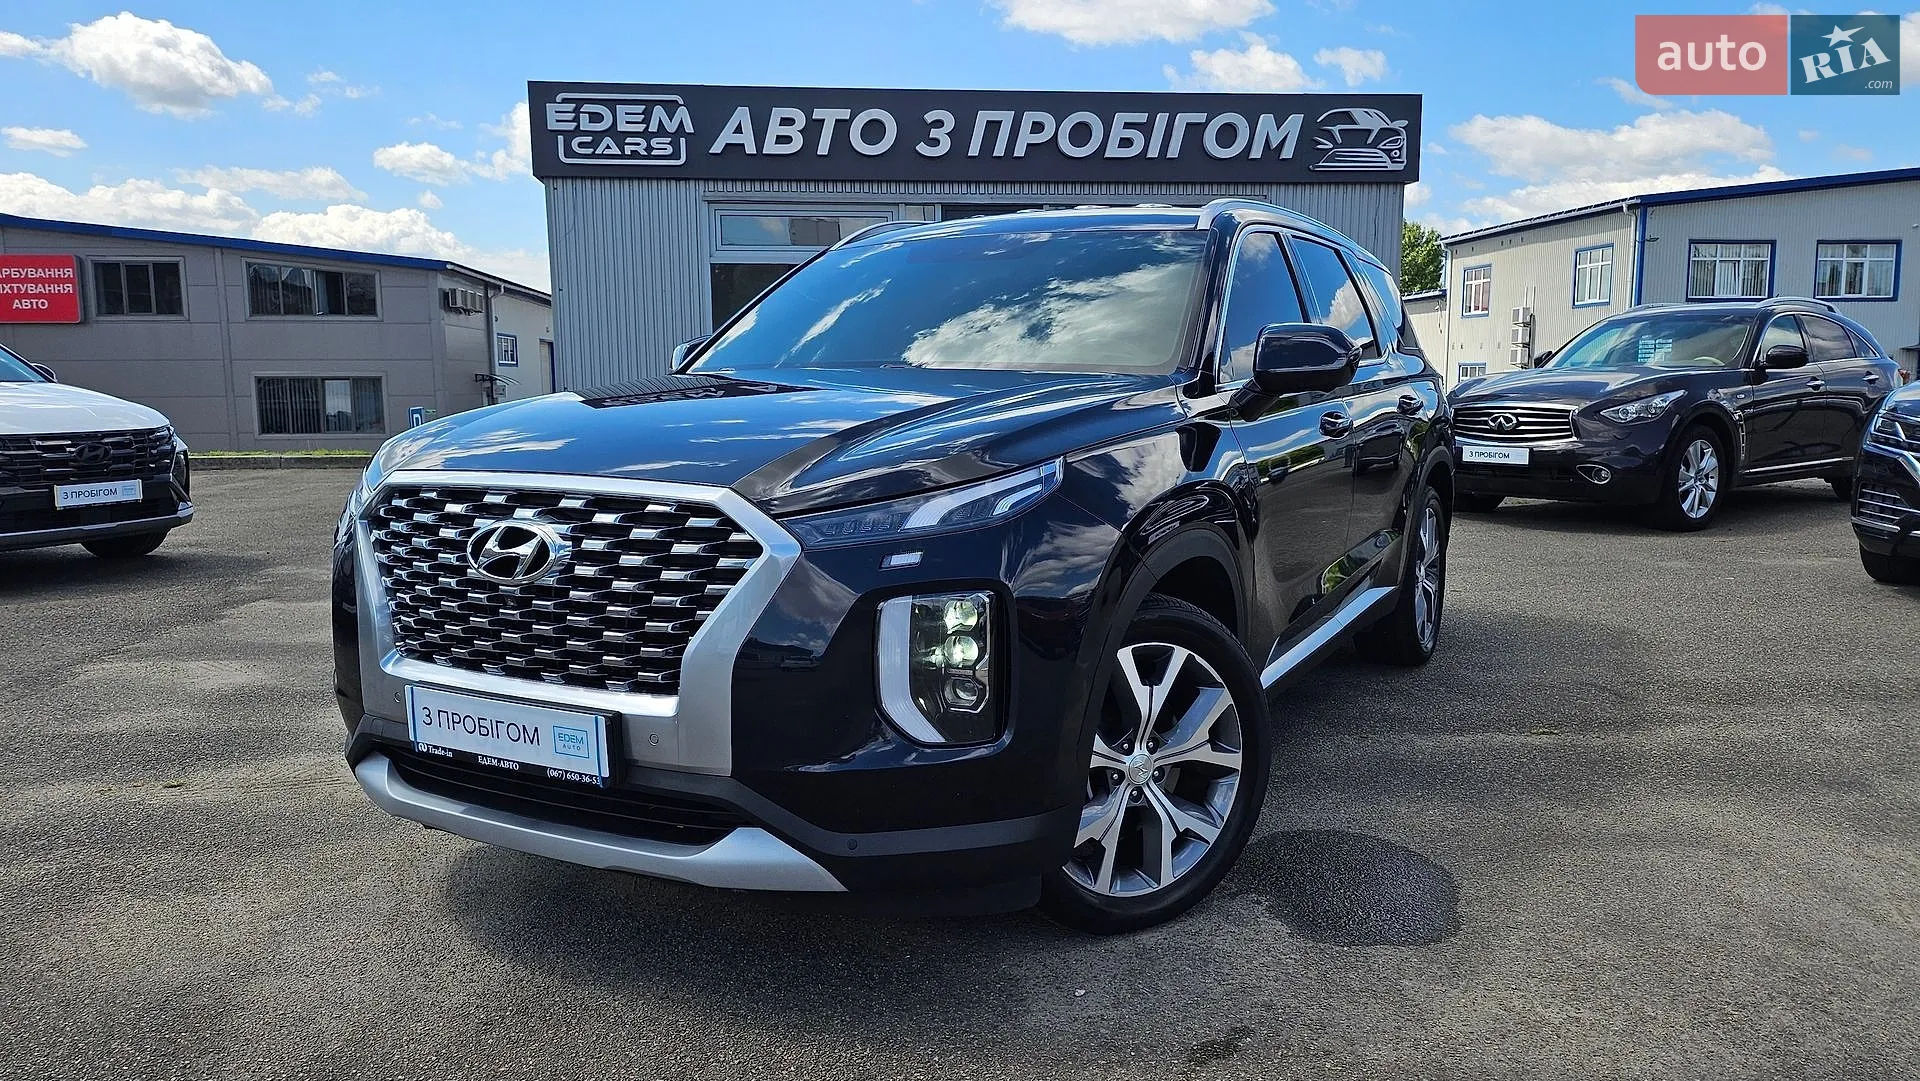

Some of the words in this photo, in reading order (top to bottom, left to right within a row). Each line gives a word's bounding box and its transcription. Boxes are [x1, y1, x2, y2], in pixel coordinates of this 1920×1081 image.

[546, 102, 695, 134] EDEM
[708, 106, 898, 156] АВТО
[914, 109, 956, 158] З
[967, 110, 1304, 159] ПРОБІГОМ
[571, 136, 673, 156] CARS
[0, 268, 73, 278] РБУВАННЯ
[0, 284, 73, 294] ХТУВАННЯ
[12, 299, 48, 309] АВТО
[1475, 451, 1510, 459] ПРОБІГОМ
[71, 487, 117, 499] ПРОБІГОМ
[437, 709, 540, 746] ПРОБІГОМ
[558, 732, 585, 745] EDEM
[428, 744, 454, 758] Trade-in
[478, 755, 519, 771] ЕДЕМ-АВТО
[547, 767, 566, 780] (067)
